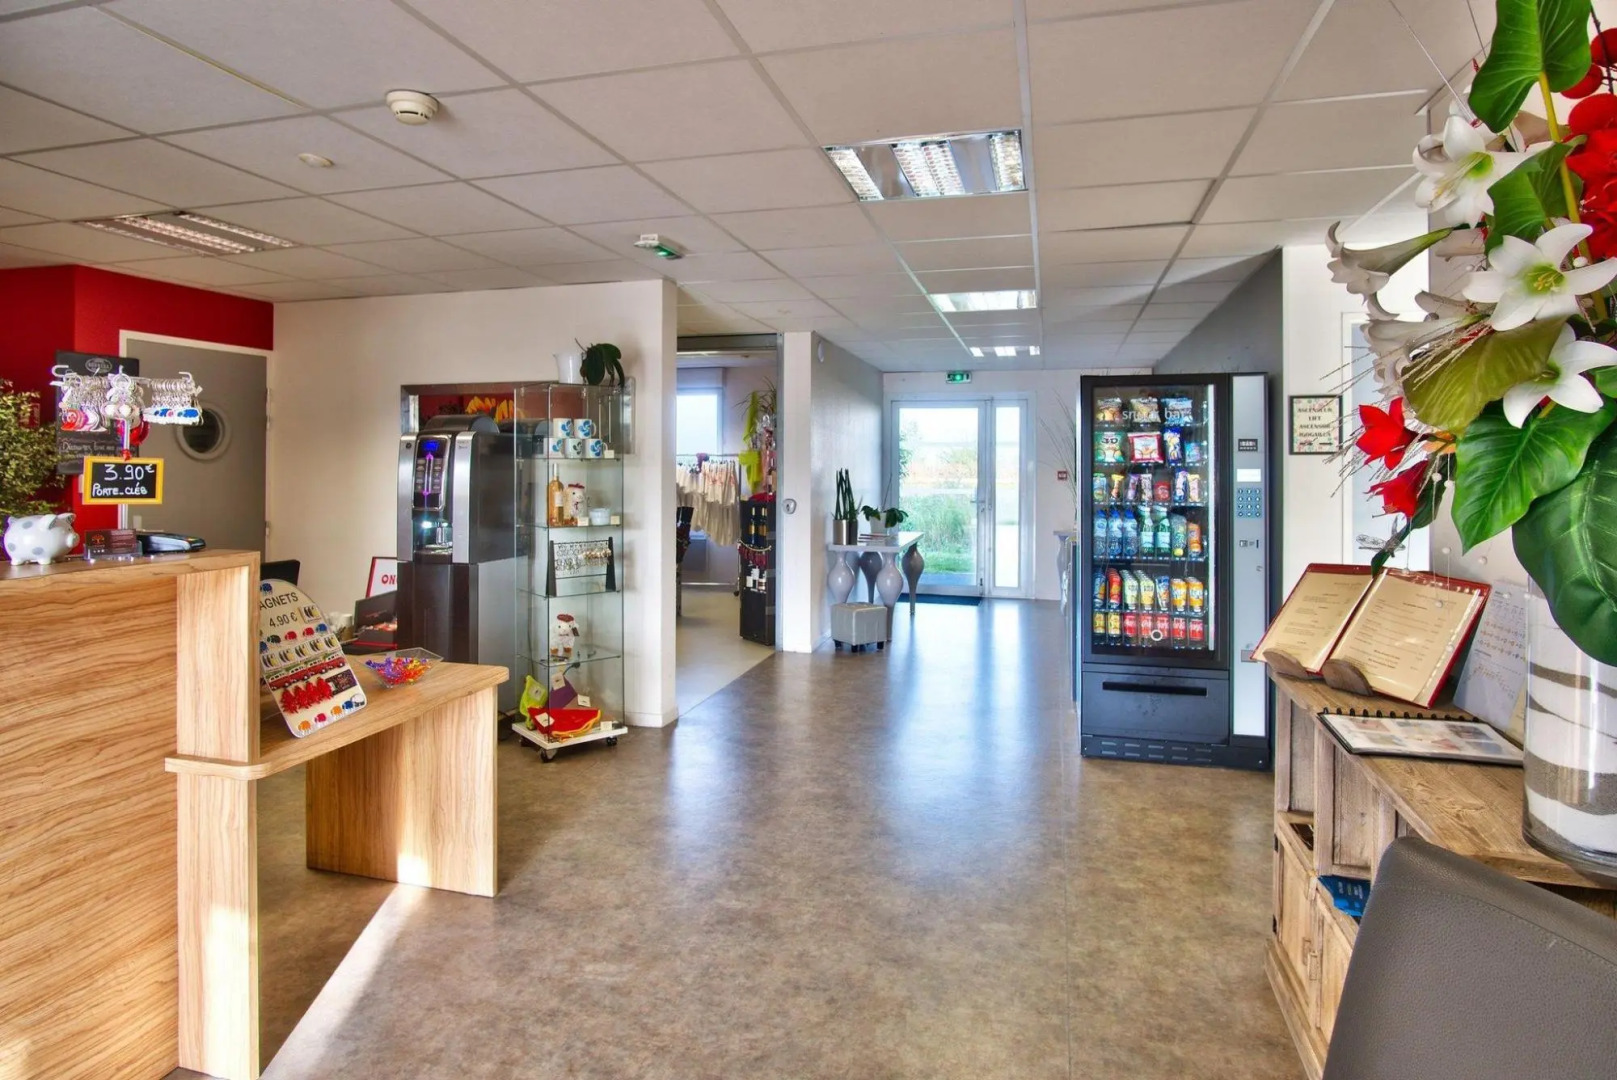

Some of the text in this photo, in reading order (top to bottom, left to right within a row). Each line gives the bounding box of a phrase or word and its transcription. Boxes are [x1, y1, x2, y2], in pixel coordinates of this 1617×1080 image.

[1122, 407, 1185, 420] snack bar
[381, 574, 397, 585] ON
[259, 591, 299, 610] AGNETS
[269, 613, 290, 629] 4.90
